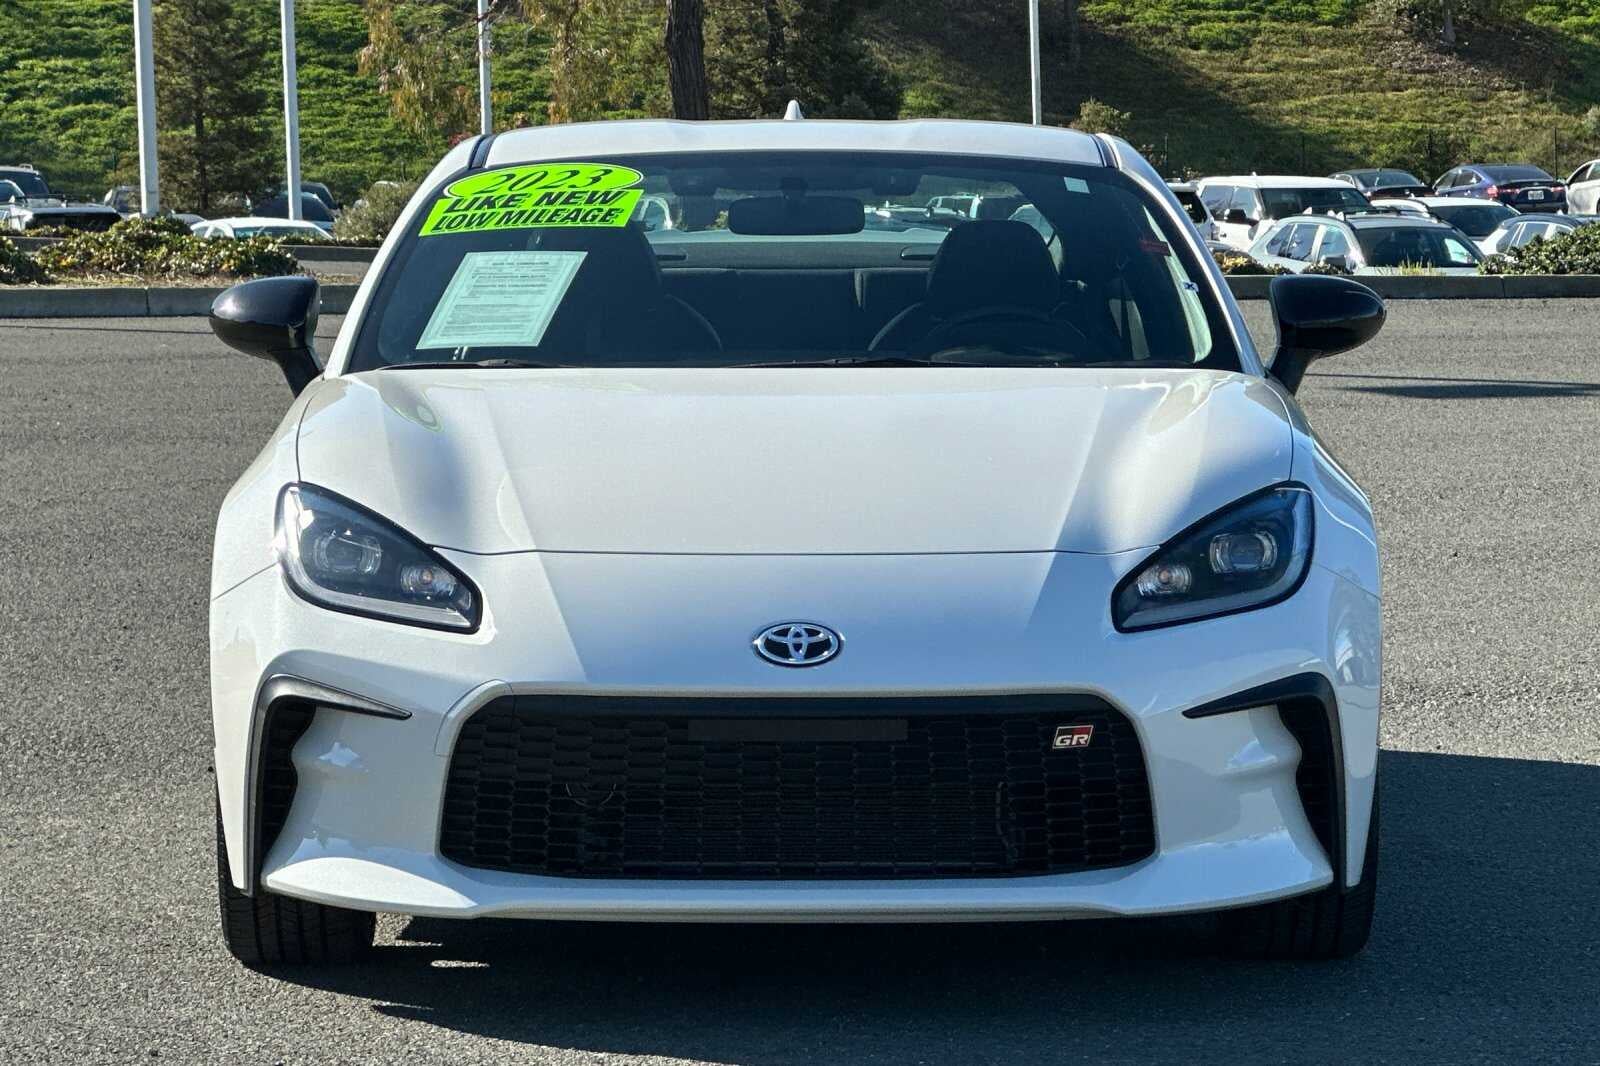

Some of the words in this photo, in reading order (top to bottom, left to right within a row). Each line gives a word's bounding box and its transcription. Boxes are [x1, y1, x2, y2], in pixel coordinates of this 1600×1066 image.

[472, 169, 613, 194] 2023
[444, 194, 530, 213] LIKE
[533, 190, 627, 206] NEW
[431, 212, 497, 231] LOW
[496, 208, 622, 226] MILEAGE
[1055, 734, 1088, 746] GR
